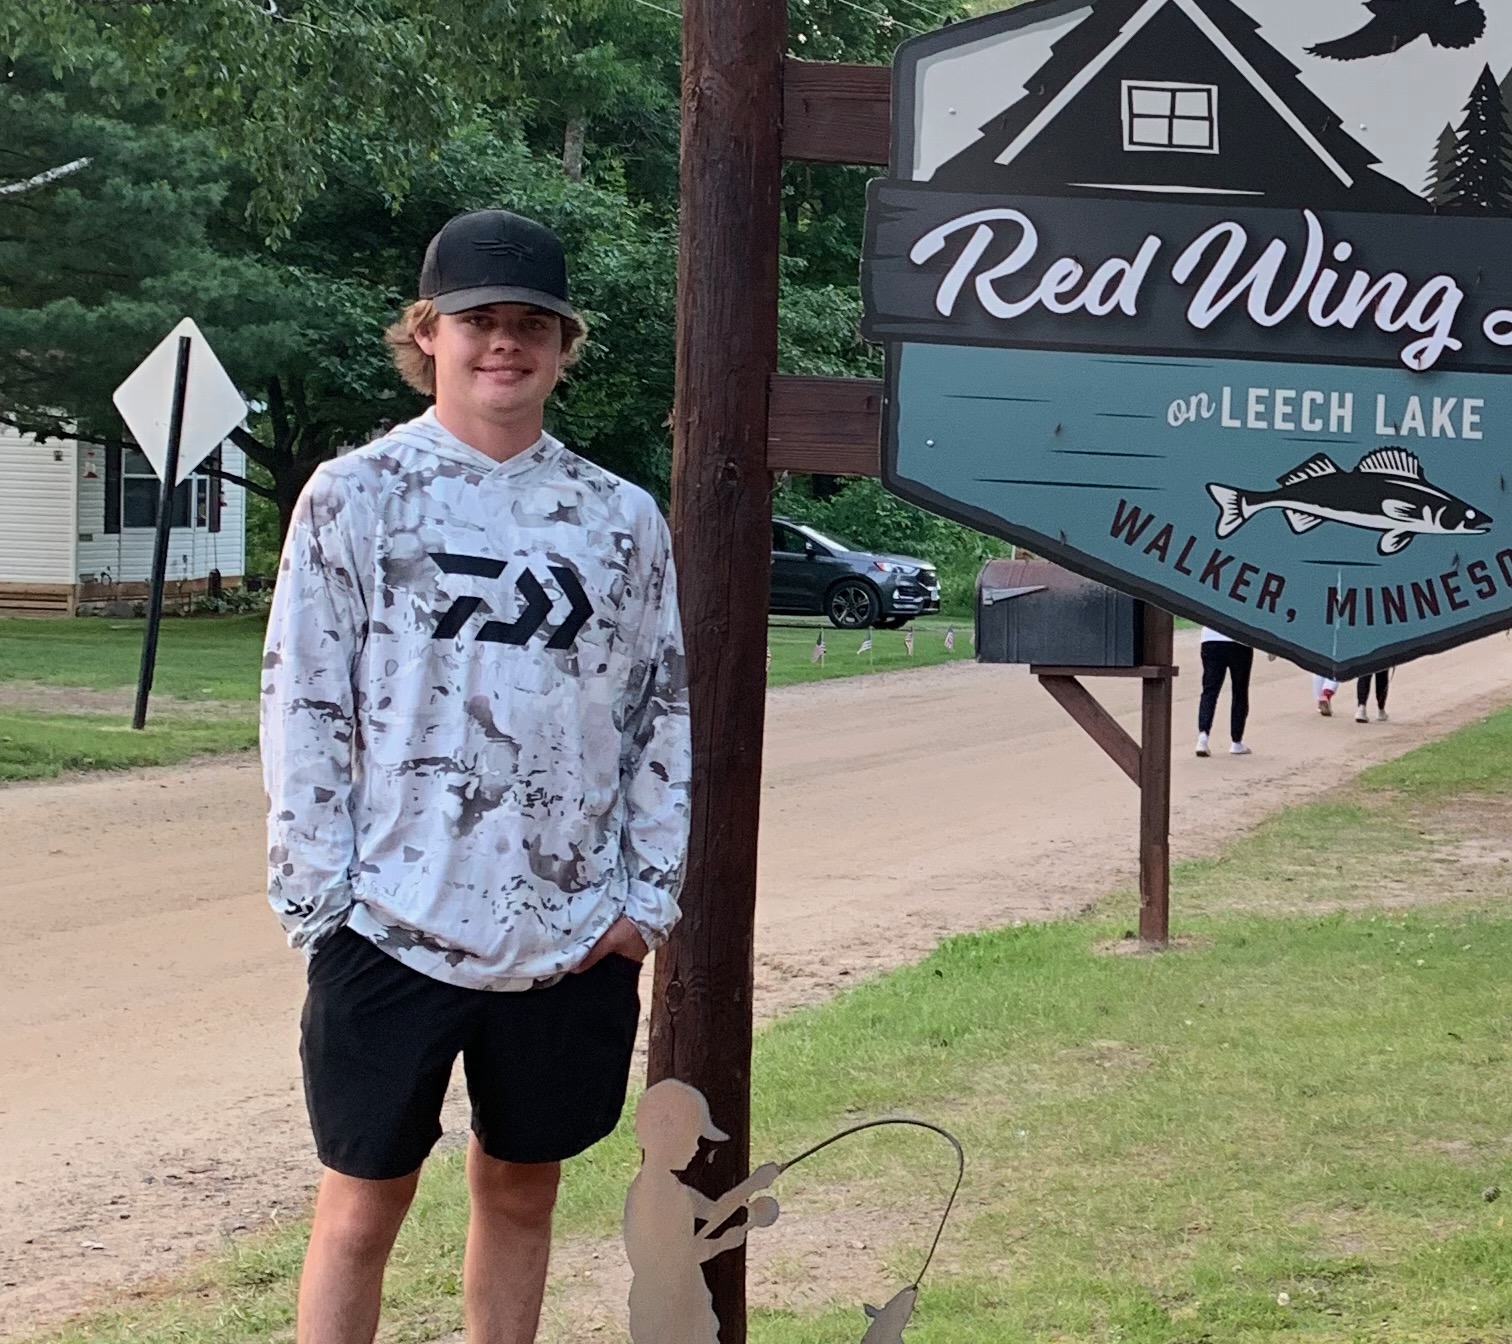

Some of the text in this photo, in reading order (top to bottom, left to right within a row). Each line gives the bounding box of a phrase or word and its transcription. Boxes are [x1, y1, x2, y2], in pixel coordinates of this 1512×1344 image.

[910, 207, 1162, 319] Red
[1171, 208, 1464, 371] Wing
[1166, 385, 1485, 440] on LEECH LAKE
[1108, 498, 1297, 624] WALKER,
